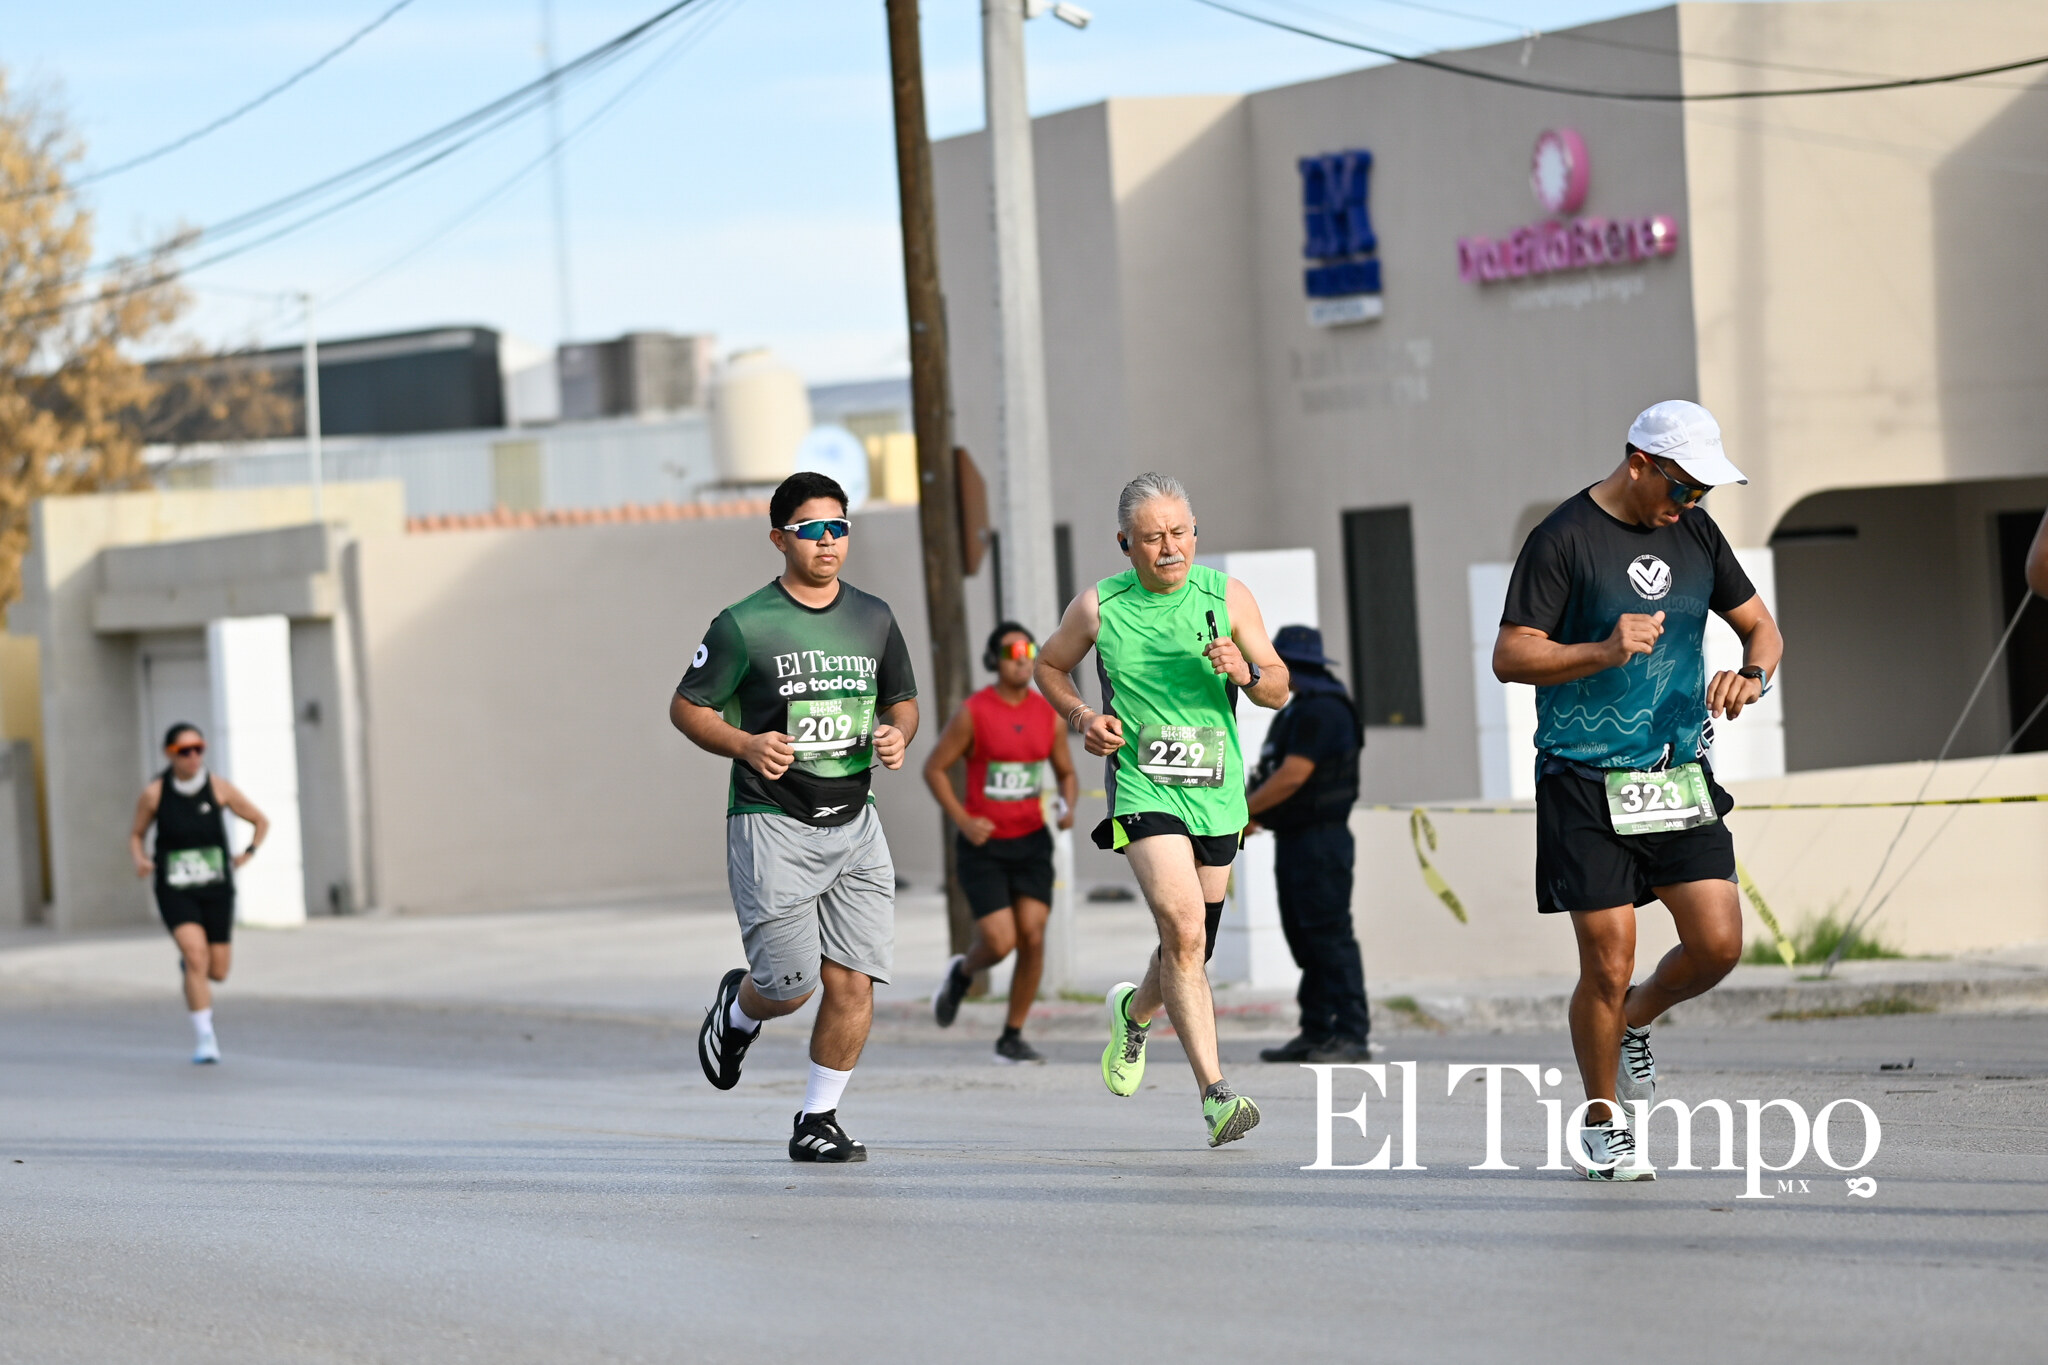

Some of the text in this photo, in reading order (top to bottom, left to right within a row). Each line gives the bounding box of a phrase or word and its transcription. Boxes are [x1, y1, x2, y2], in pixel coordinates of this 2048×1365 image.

[773, 650, 877, 678] El Tiempo
[779, 675, 867, 697] de todos
[798, 714, 852, 742] 209
[860, 709, 871, 747] MEDALLA
[1149, 741, 1205, 767] 229
[1216, 741, 1224, 780] MEDALLA
[994, 772, 1031, 788] 107
[1620, 781, 1683, 813] 323
[1694, 776, 1713, 817] MEDALLA
